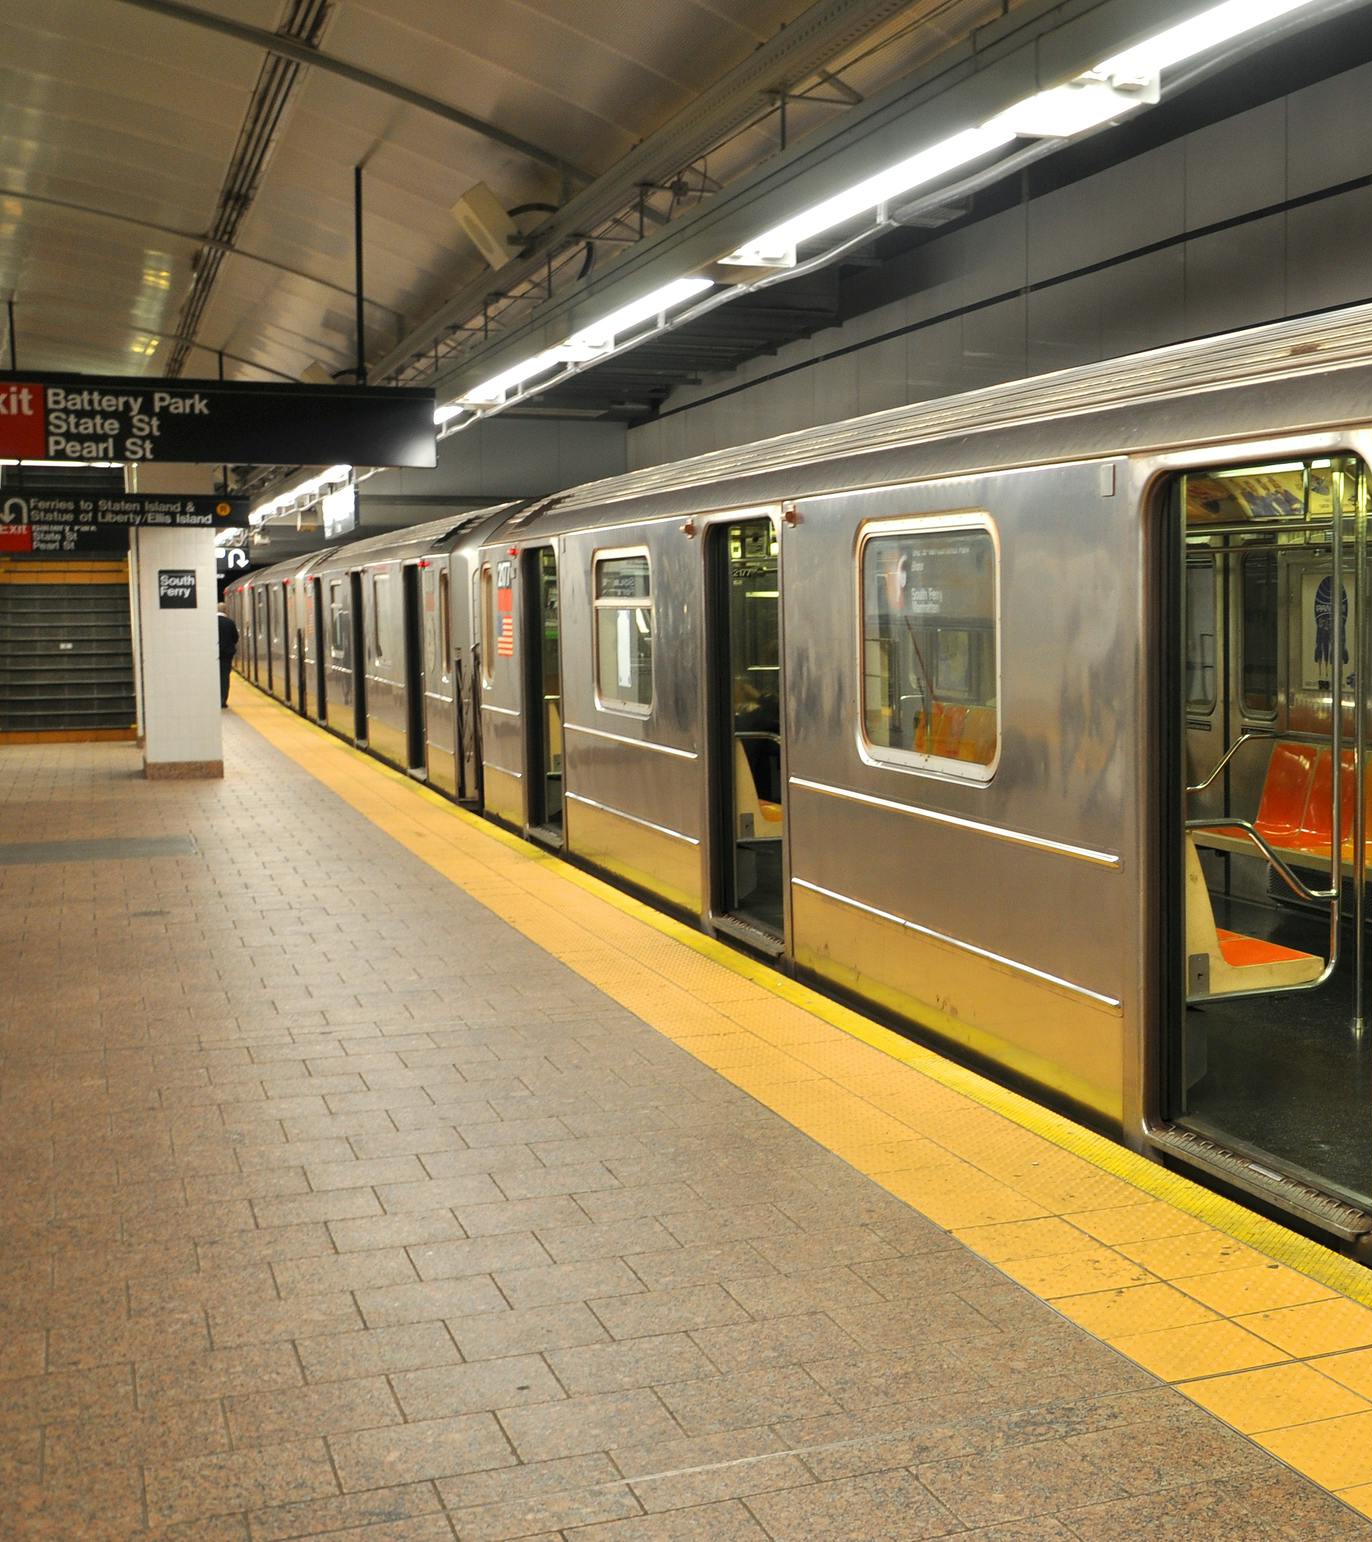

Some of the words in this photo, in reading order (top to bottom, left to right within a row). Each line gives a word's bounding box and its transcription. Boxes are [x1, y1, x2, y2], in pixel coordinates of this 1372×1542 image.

[46, 388, 144, 416] Battery
[153, 392, 210, 415] Park
[48, 411, 120, 435] State
[131, 415, 161, 437] St
[48, 436, 114, 458] Pearl
[125, 438, 154, 460] St
[30, 497, 75, 510] Ferries
[79, 499, 93, 511] to
[98, 499, 140, 512] Staten
[145, 500, 181, 512] Island
[31, 510, 75, 522] Statue
[79, 511, 93, 522] of
[98, 511, 172, 525] Liberty/Ellis
[176, 513, 213, 524] Island
[160, 574, 195, 586] South
[160, 586, 192, 599] Ferry
